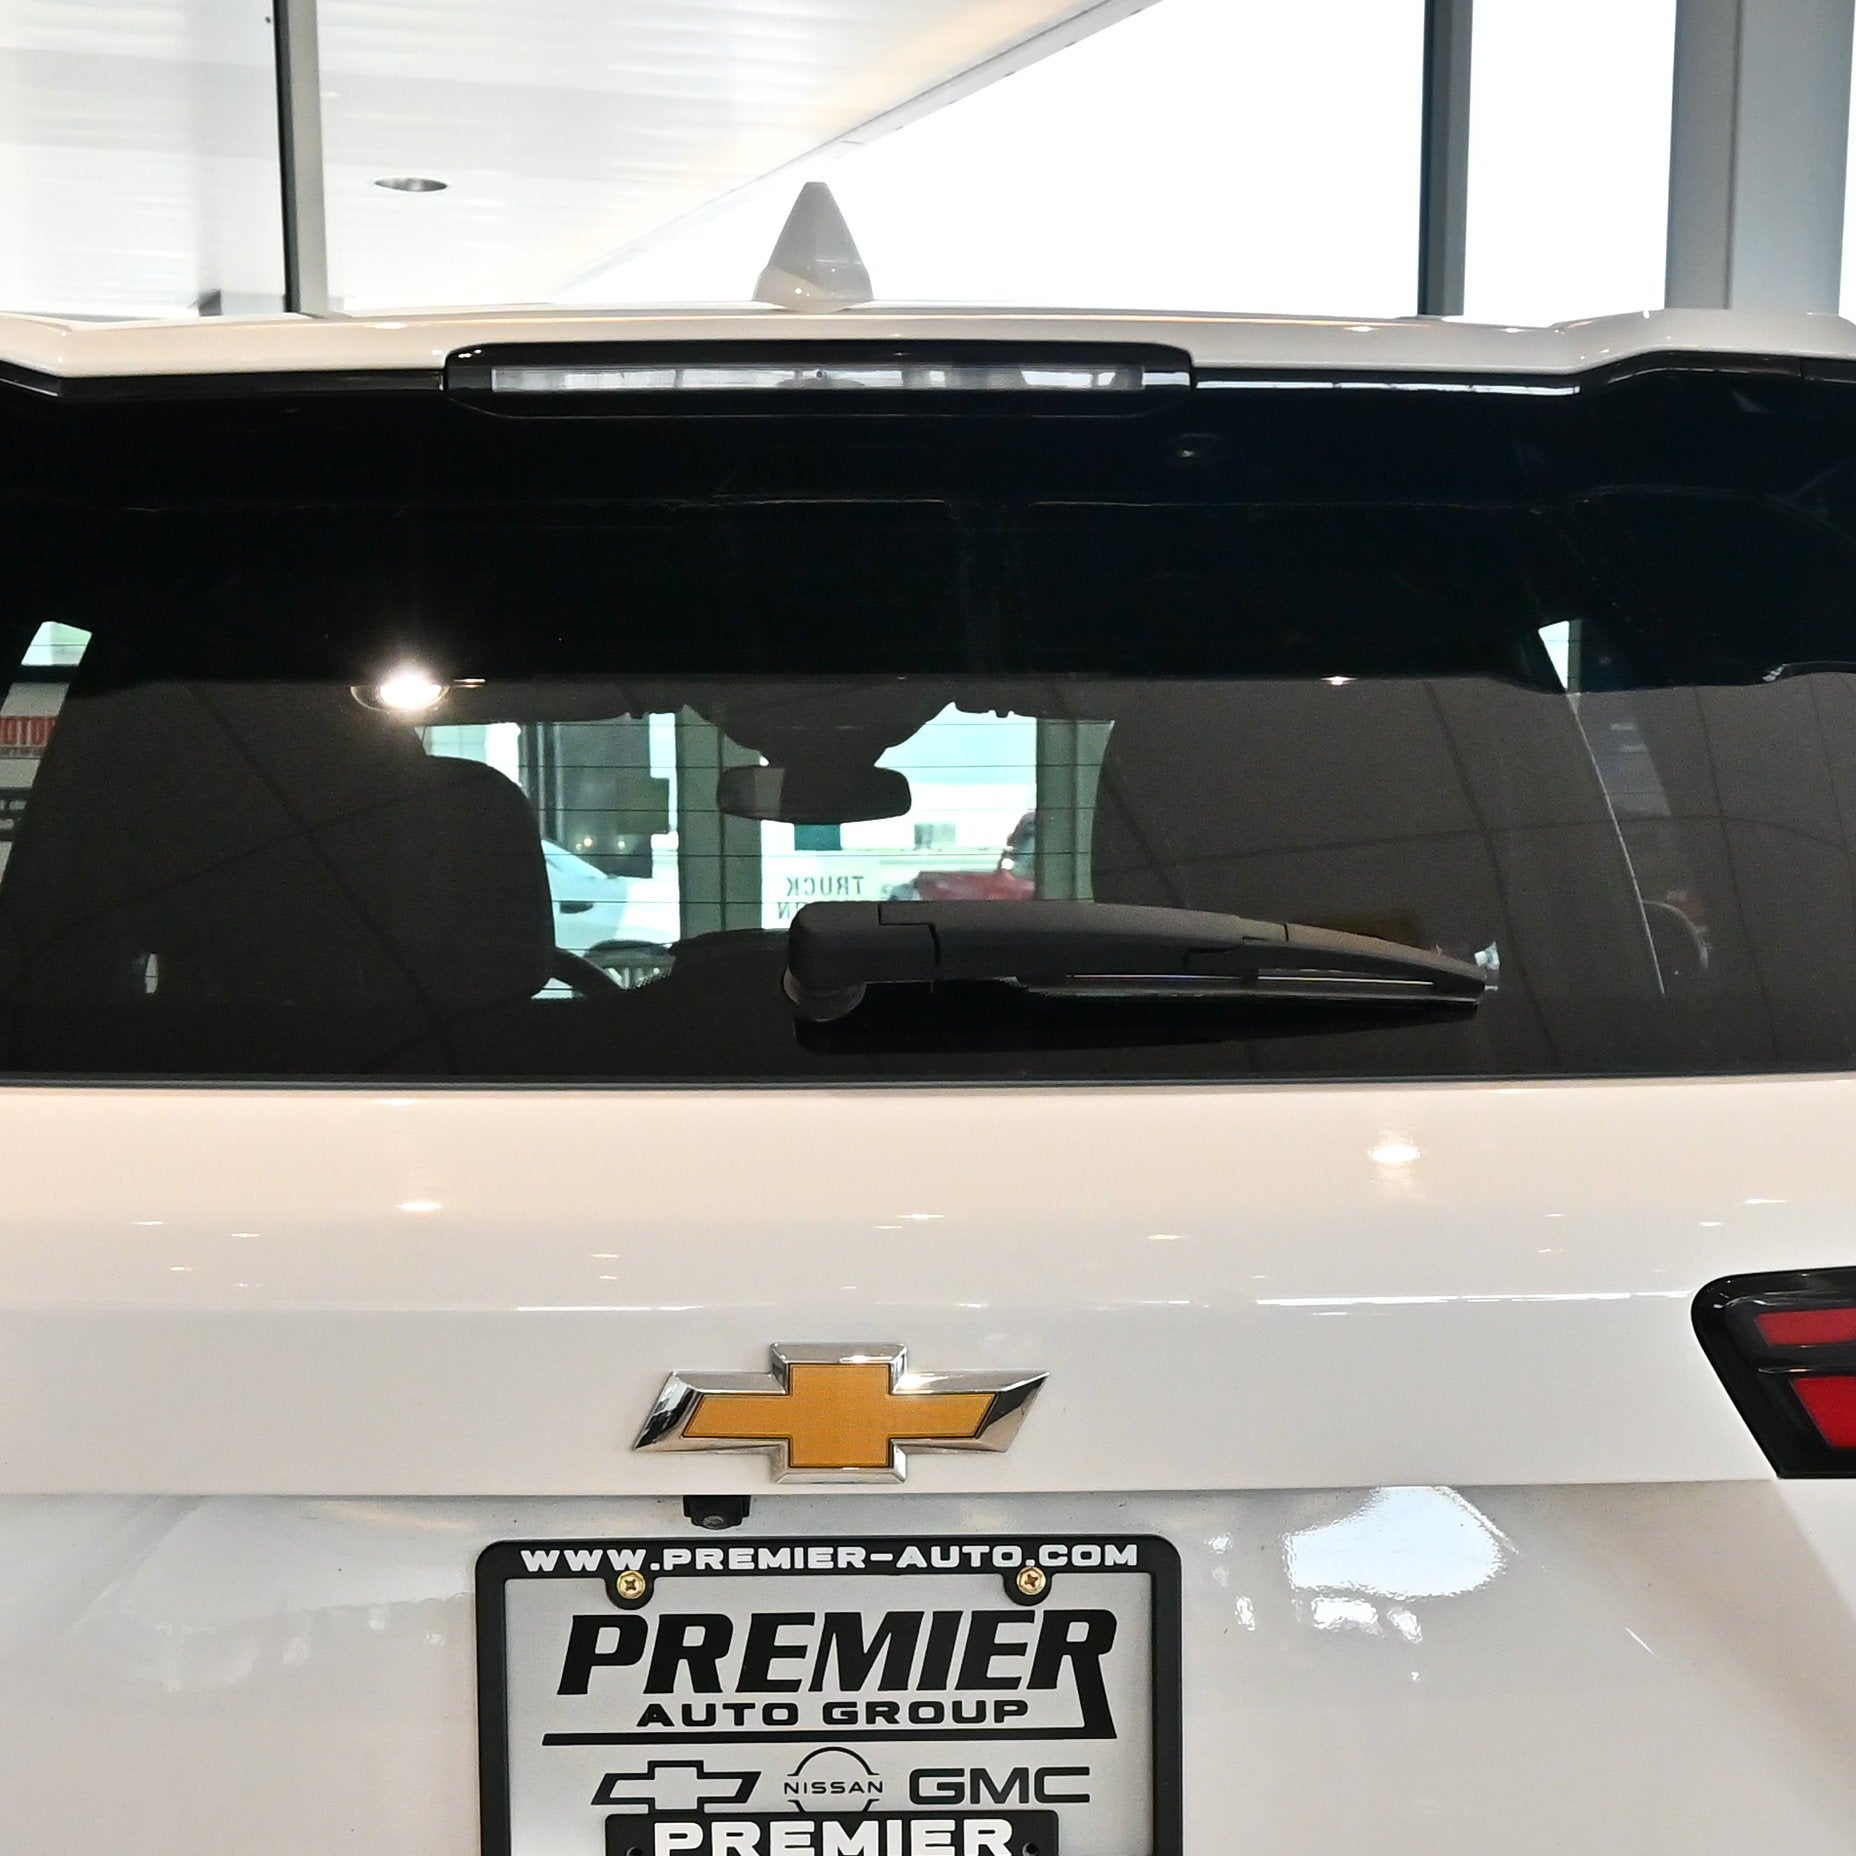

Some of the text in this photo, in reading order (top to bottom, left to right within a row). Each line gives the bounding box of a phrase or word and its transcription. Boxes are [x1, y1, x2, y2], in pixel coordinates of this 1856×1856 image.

[520, 1544, 1138, 1573] WWW.PREMIER-AUTO.COM
[556, 1608, 1118, 1739] PREMIER
[636, 1700, 1029, 1728] AUTO GROUP
[783, 1766, 1091, 1805] NISSAN GMC
